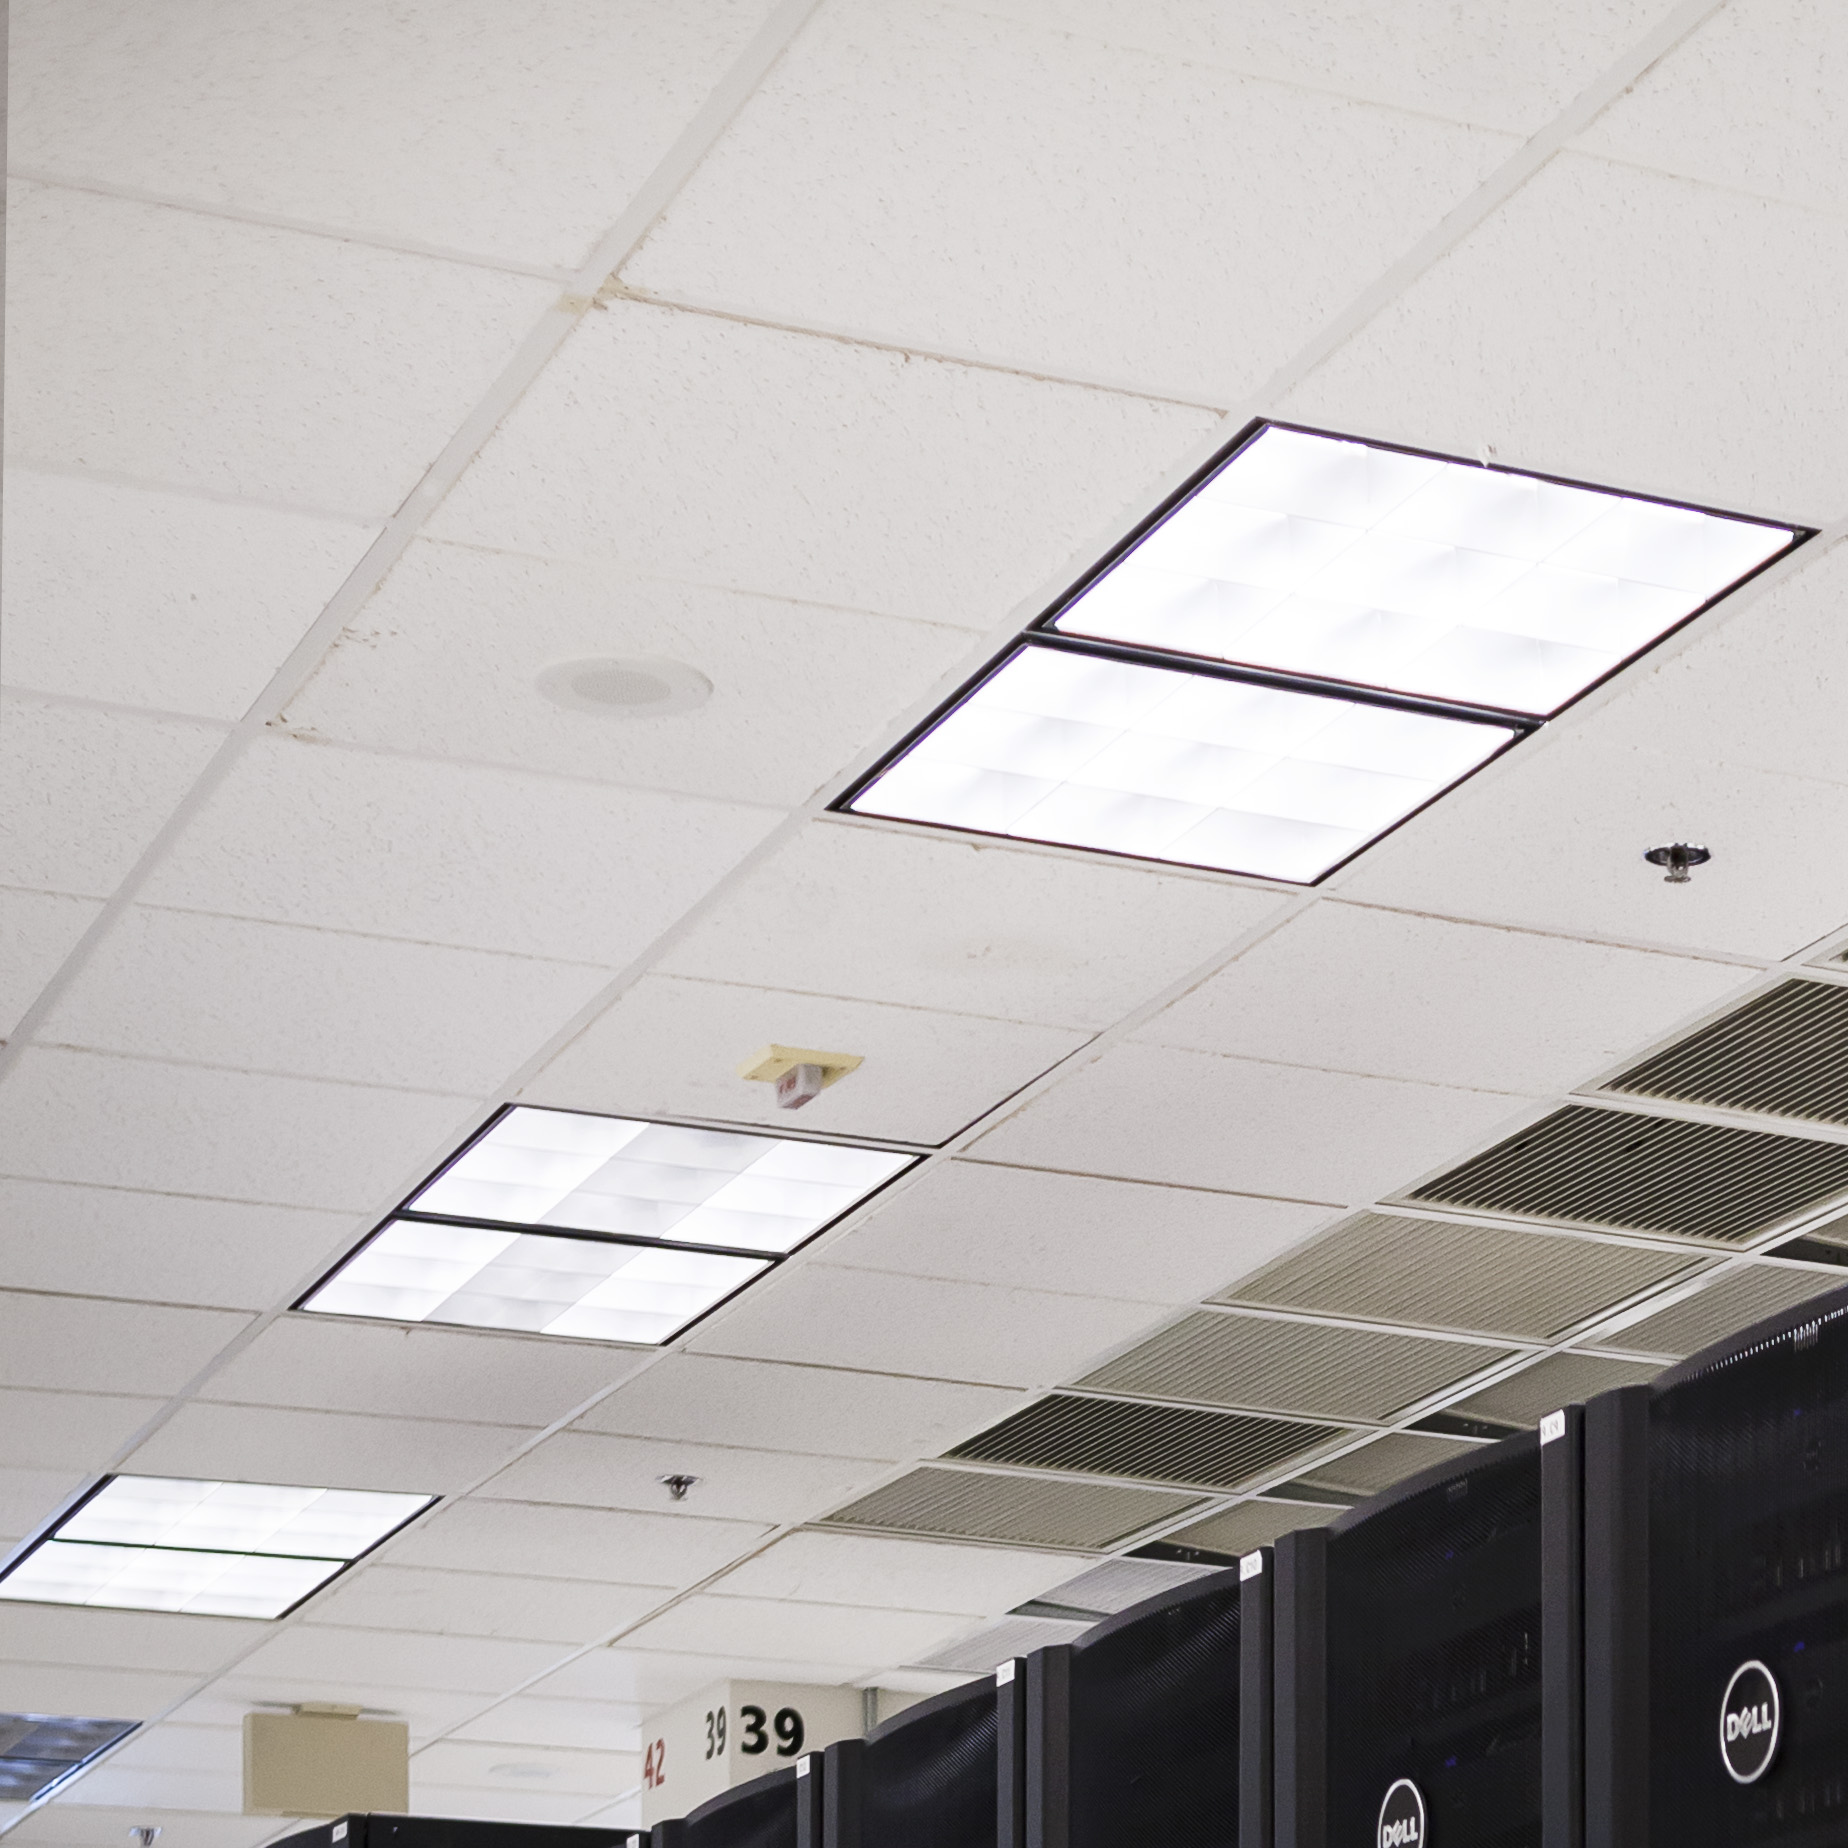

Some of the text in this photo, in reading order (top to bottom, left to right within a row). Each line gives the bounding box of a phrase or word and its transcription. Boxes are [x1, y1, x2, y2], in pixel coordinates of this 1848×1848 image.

[705, 1705, 727, 1761] 39
[740, 1705, 805, 1757] 39
[1727, 1702, 1771, 1742] DELL
[643, 1737, 666, 1790] 42
